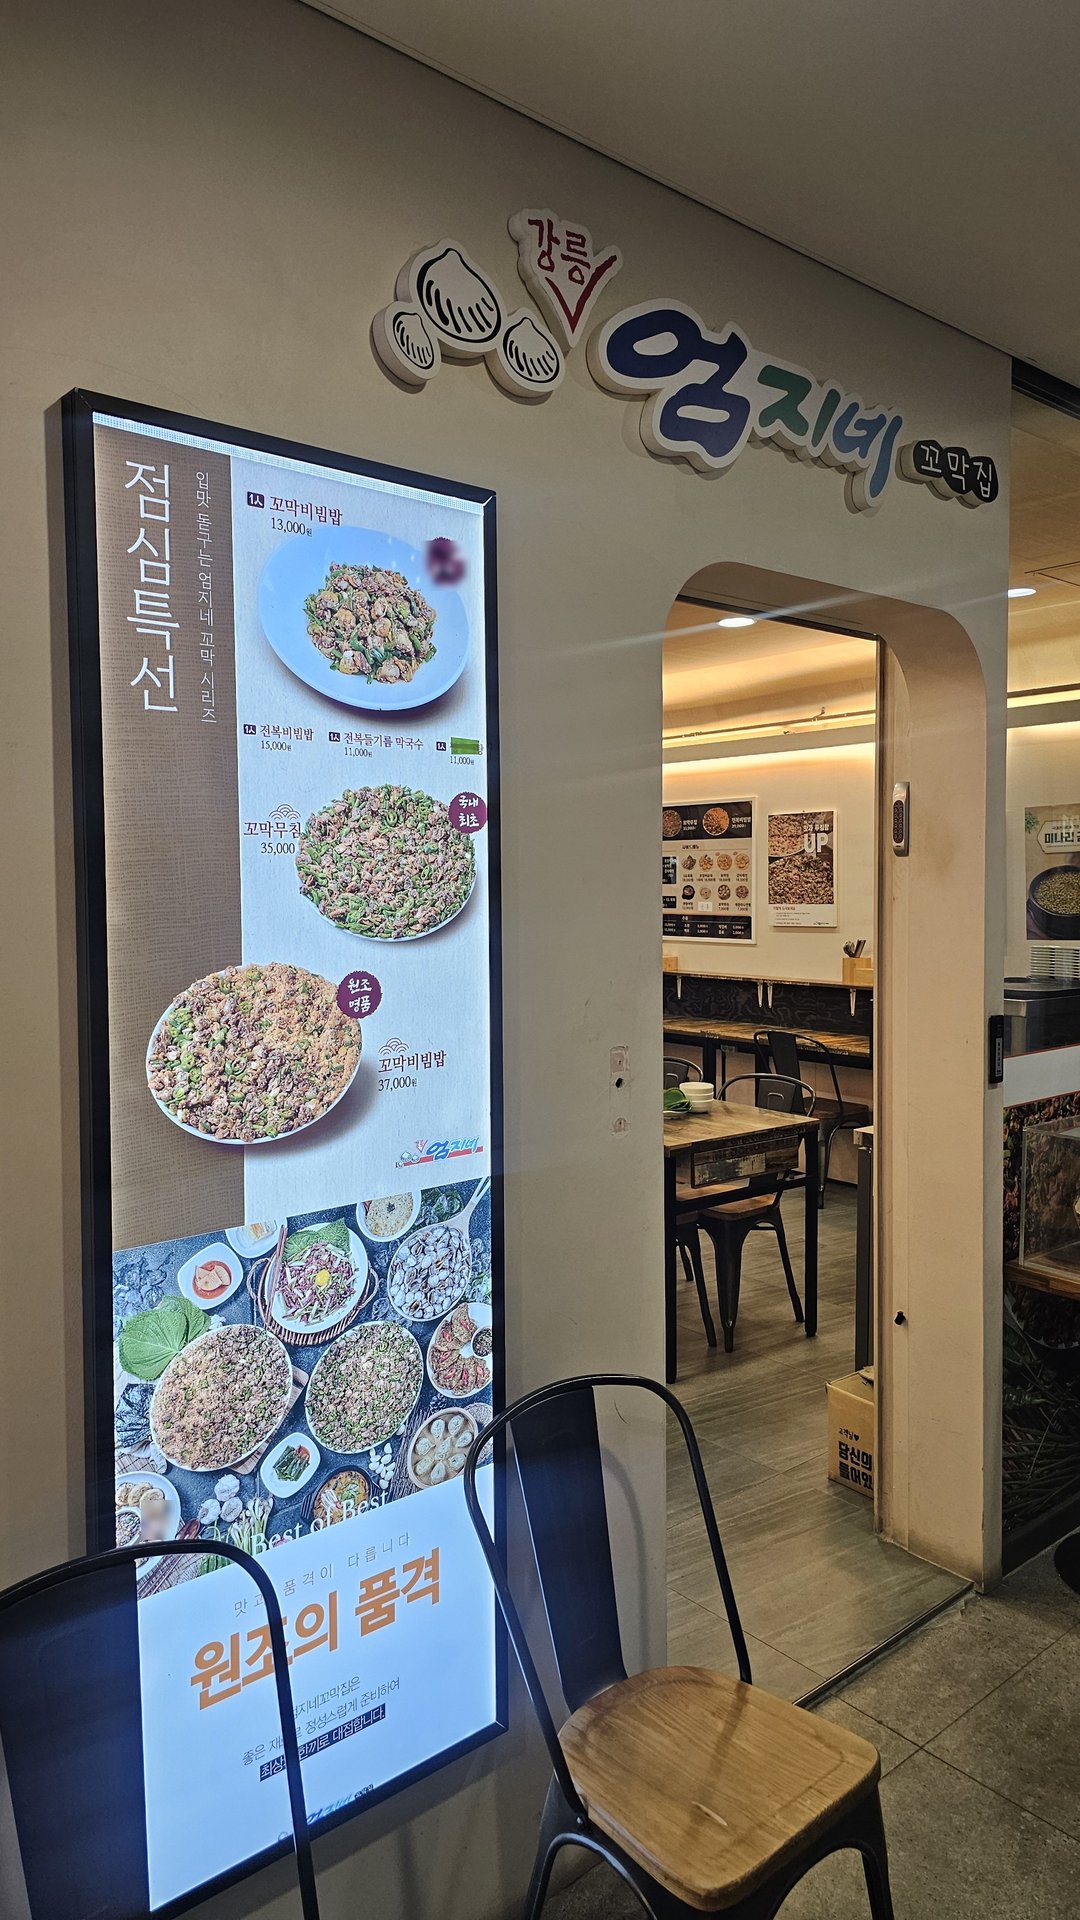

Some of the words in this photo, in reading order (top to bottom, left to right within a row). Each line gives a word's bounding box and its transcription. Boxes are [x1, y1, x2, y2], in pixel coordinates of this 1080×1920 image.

[527, 218, 592, 286] 강릉
[605, 309, 903, 498] 엄지네
[918, 441, 995, 499] 꼬막집
[196, 471, 212, 508] 입맛
[269, 496, 343, 526] 꼬막비빔밥
[124, 460, 181, 712] 점심특선
[198, 572, 213, 626] 엄지네
[199, 632, 215, 667] 꼬막
[200, 671, 217, 723] 시리즈
[260, 724, 315, 741] 전복비빔밥
[343, 732, 393, 748] 전복들기름
[395, 736, 424, 751] 막국수
[458, 795, 479, 809] 국내
[243, 821, 301, 839] 꼬막무침
[458, 813, 480, 827] 최초
[260, 842, 296, 855] 35,000
[803, 832, 829, 853] UP
[1044, 831, 1075, 844] 미나리
[347, 978, 372, 993] 원조
[348, 996, 371, 1013] 명품
[378, 1049, 447, 1073] 꼬막비빔밥
[426, 1137, 479, 1161] 엄지네
[838, 1440, 873, 1472] 당신의
[250, 1523, 302, 1557] Best
[341, 1491, 388, 1522] Best
[283, 1563, 333, 1597] 품격이
[190, 1590, 338, 1711] 원조의
[355, 1546, 440, 1637] 품격
[242, 1743, 266, 1766] 좋은
[305, 1697, 358, 1735] 정성스럽게
[360, 1677, 400, 1707] 준비하여
[332, 1706, 385, 1741] 대접합니다.
